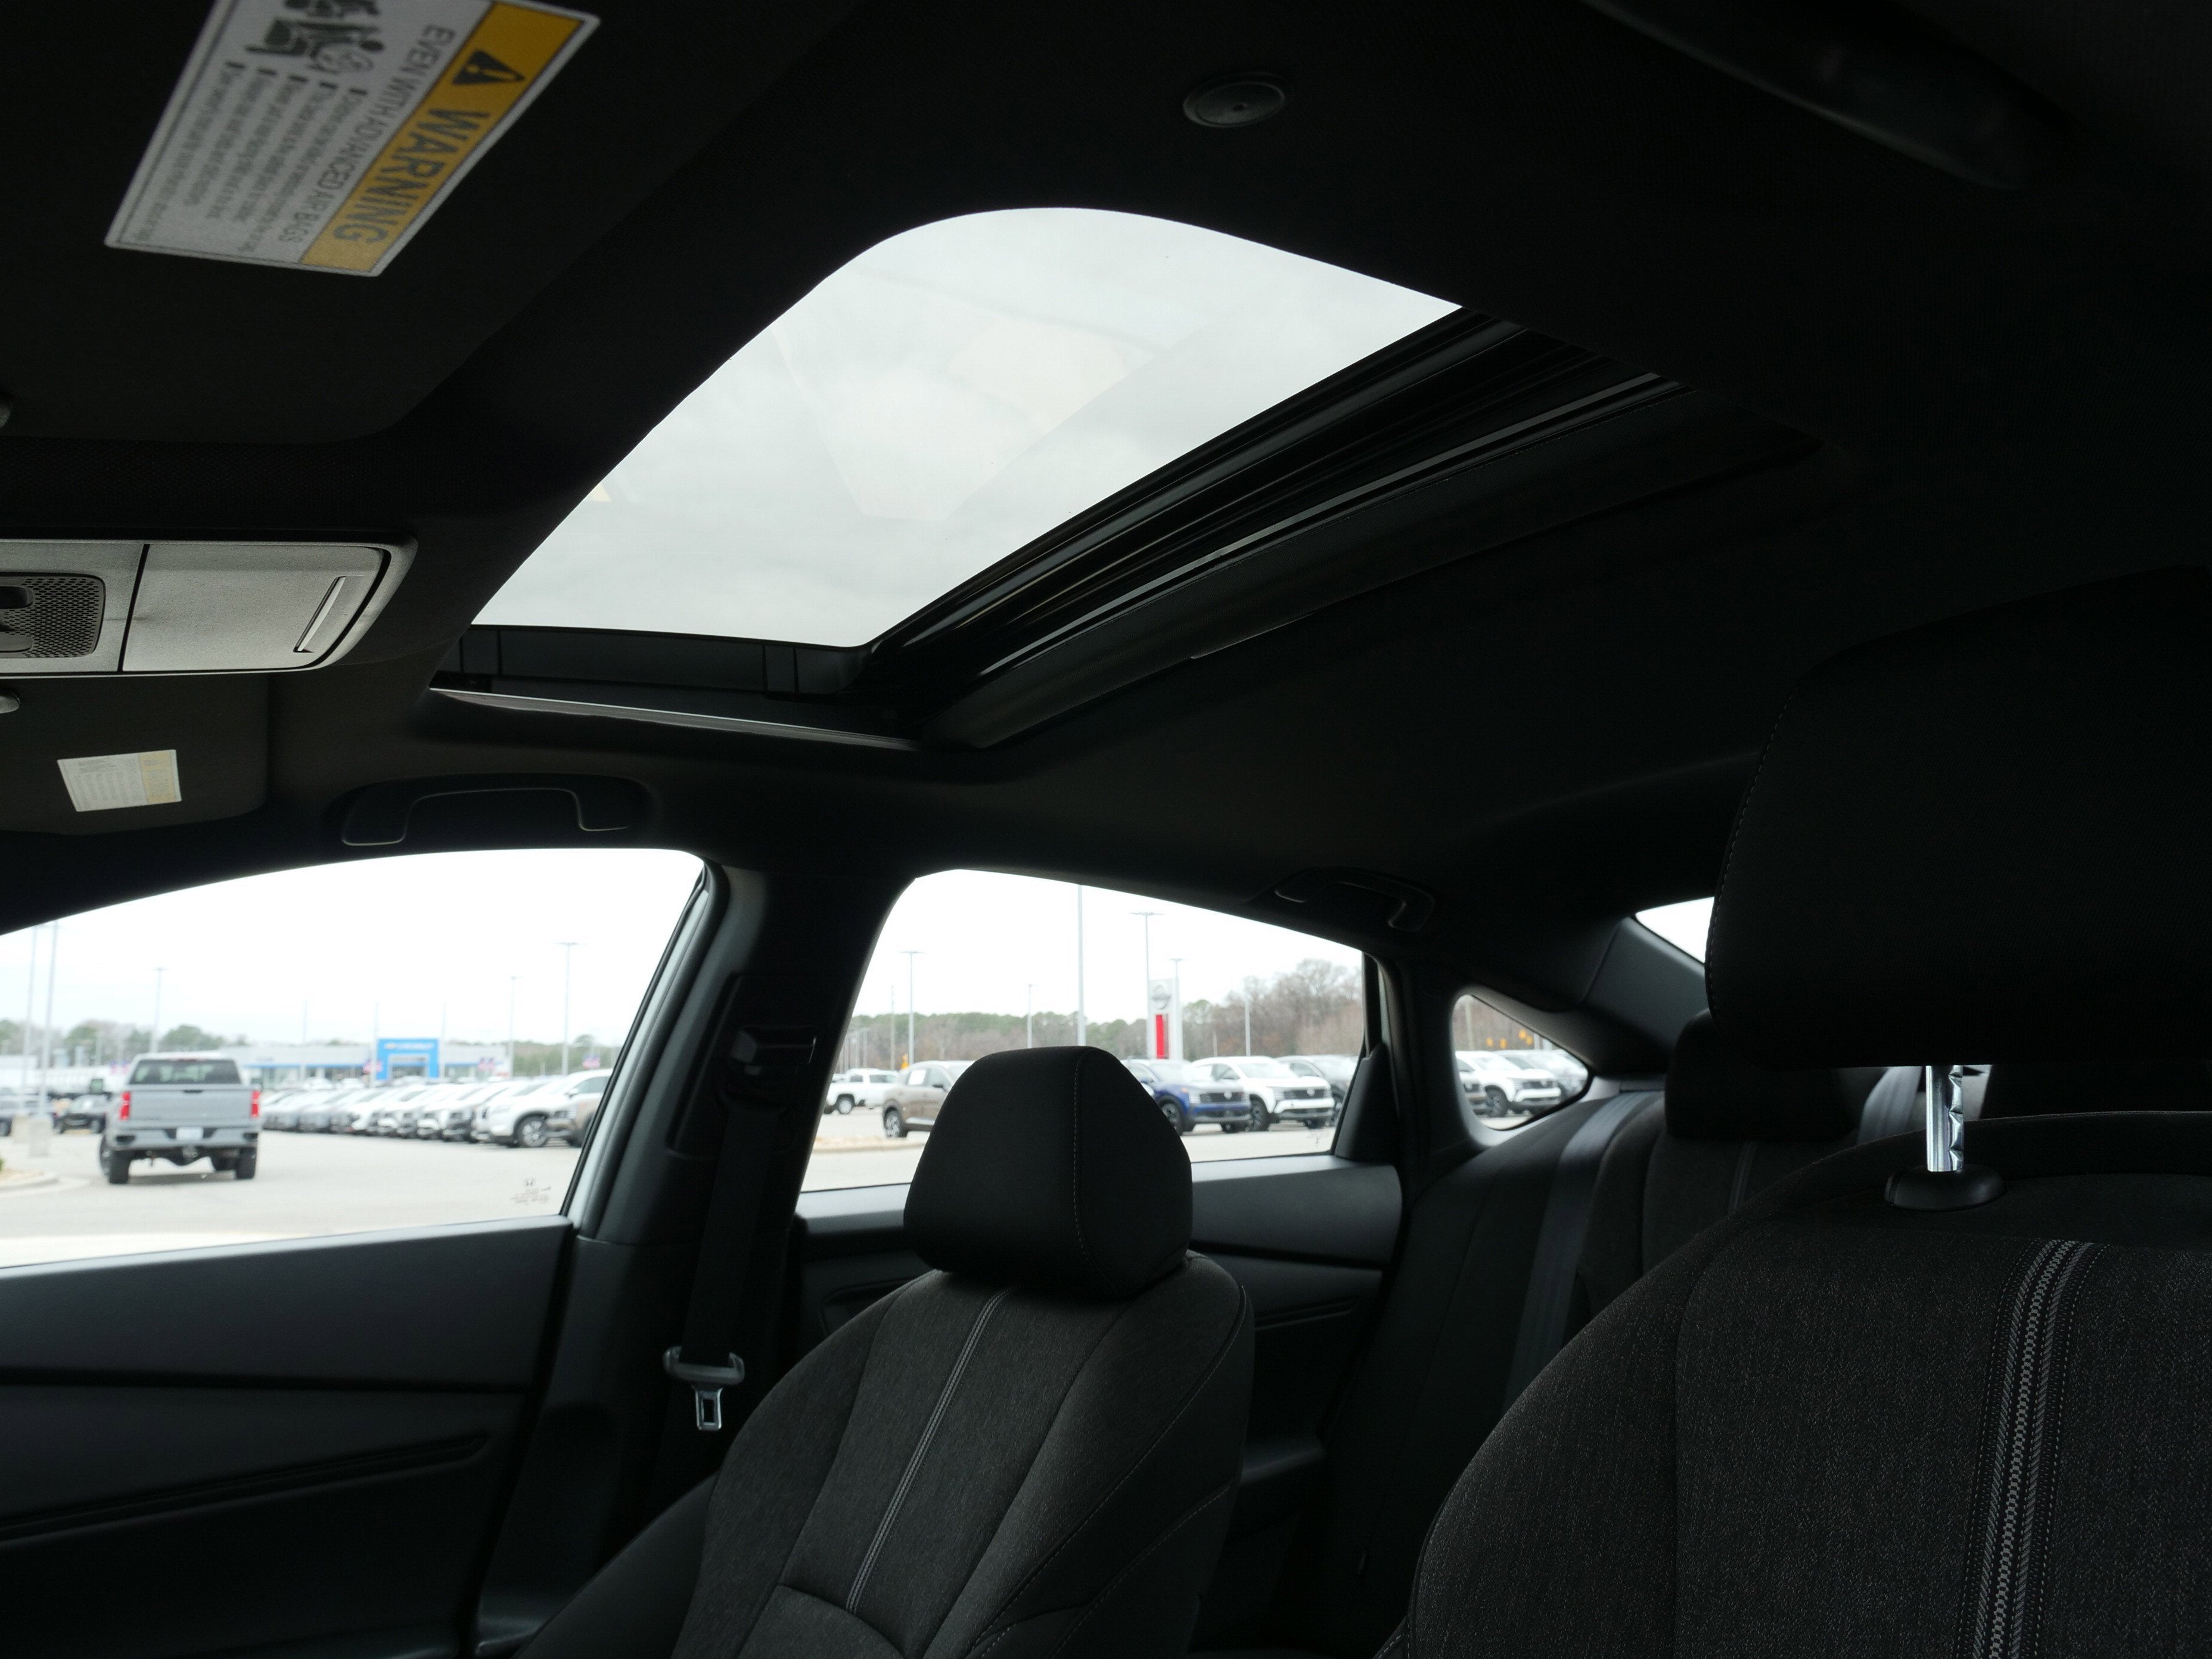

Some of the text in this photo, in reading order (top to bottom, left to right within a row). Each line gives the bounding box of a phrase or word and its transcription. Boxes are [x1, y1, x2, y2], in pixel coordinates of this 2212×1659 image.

[400, 24, 456, 76] EVEN
[366, 76, 421, 117] WITH
[316, 117, 387, 190] ADVANCED
[333, 109, 490, 243] WARNING
[304, 189, 334, 210] AIR
[278, 212, 320, 243] BAGS
